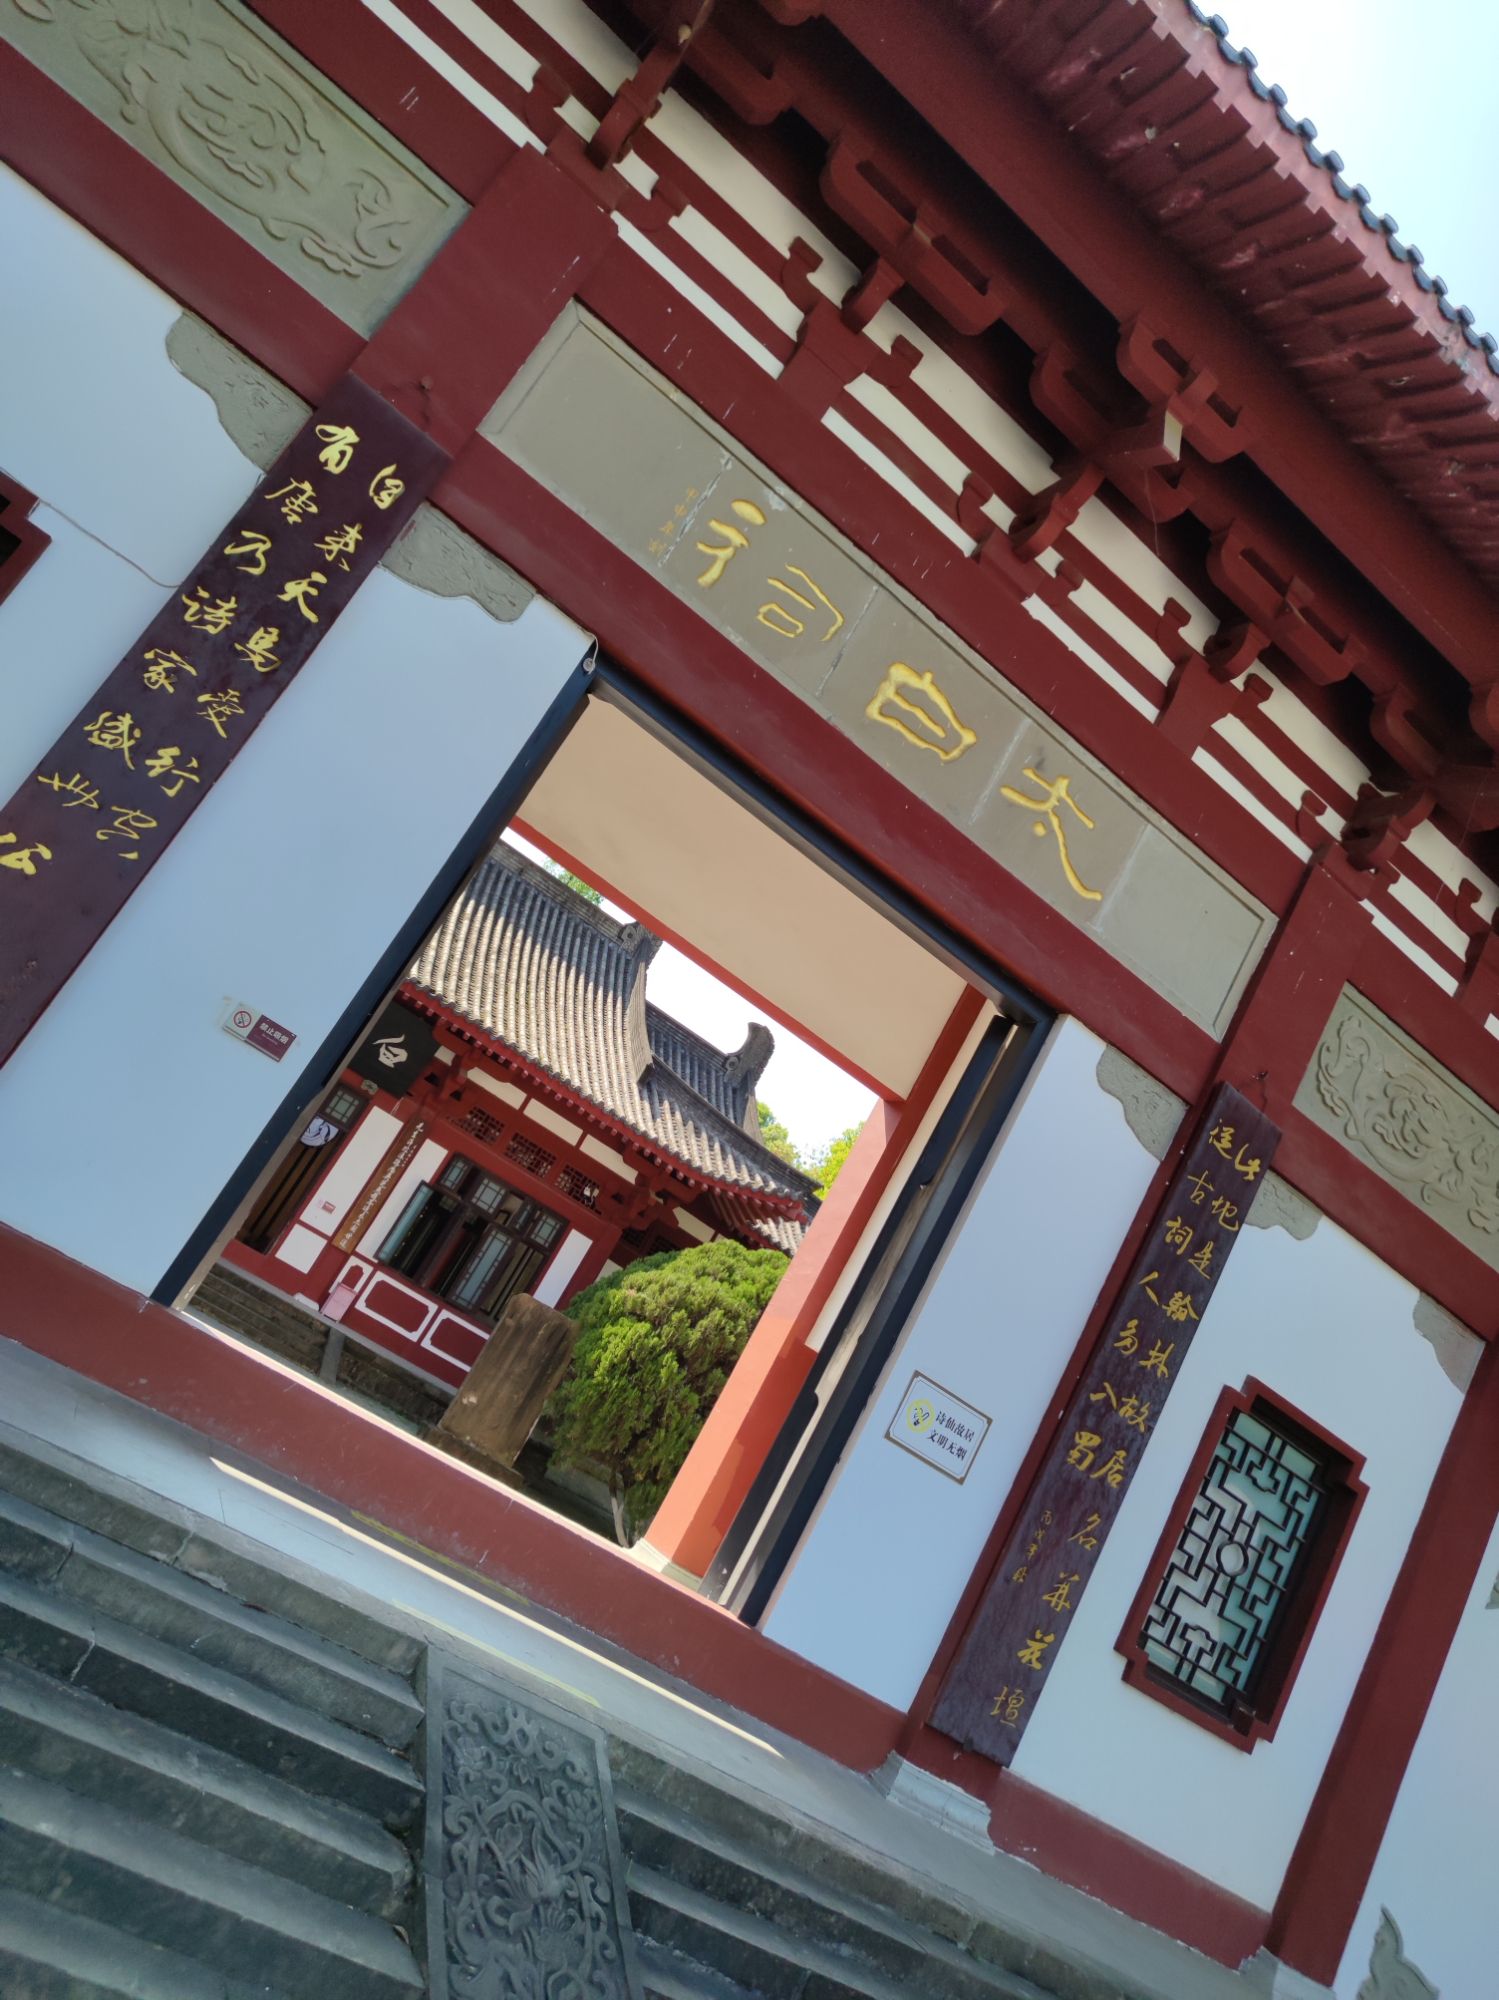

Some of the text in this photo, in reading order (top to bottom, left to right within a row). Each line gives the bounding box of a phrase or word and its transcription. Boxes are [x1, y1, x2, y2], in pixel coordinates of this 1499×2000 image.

[935, 1410, 975, 1442] 诗仙故居
[926, 1428, 967, 1461] 文明无烟
